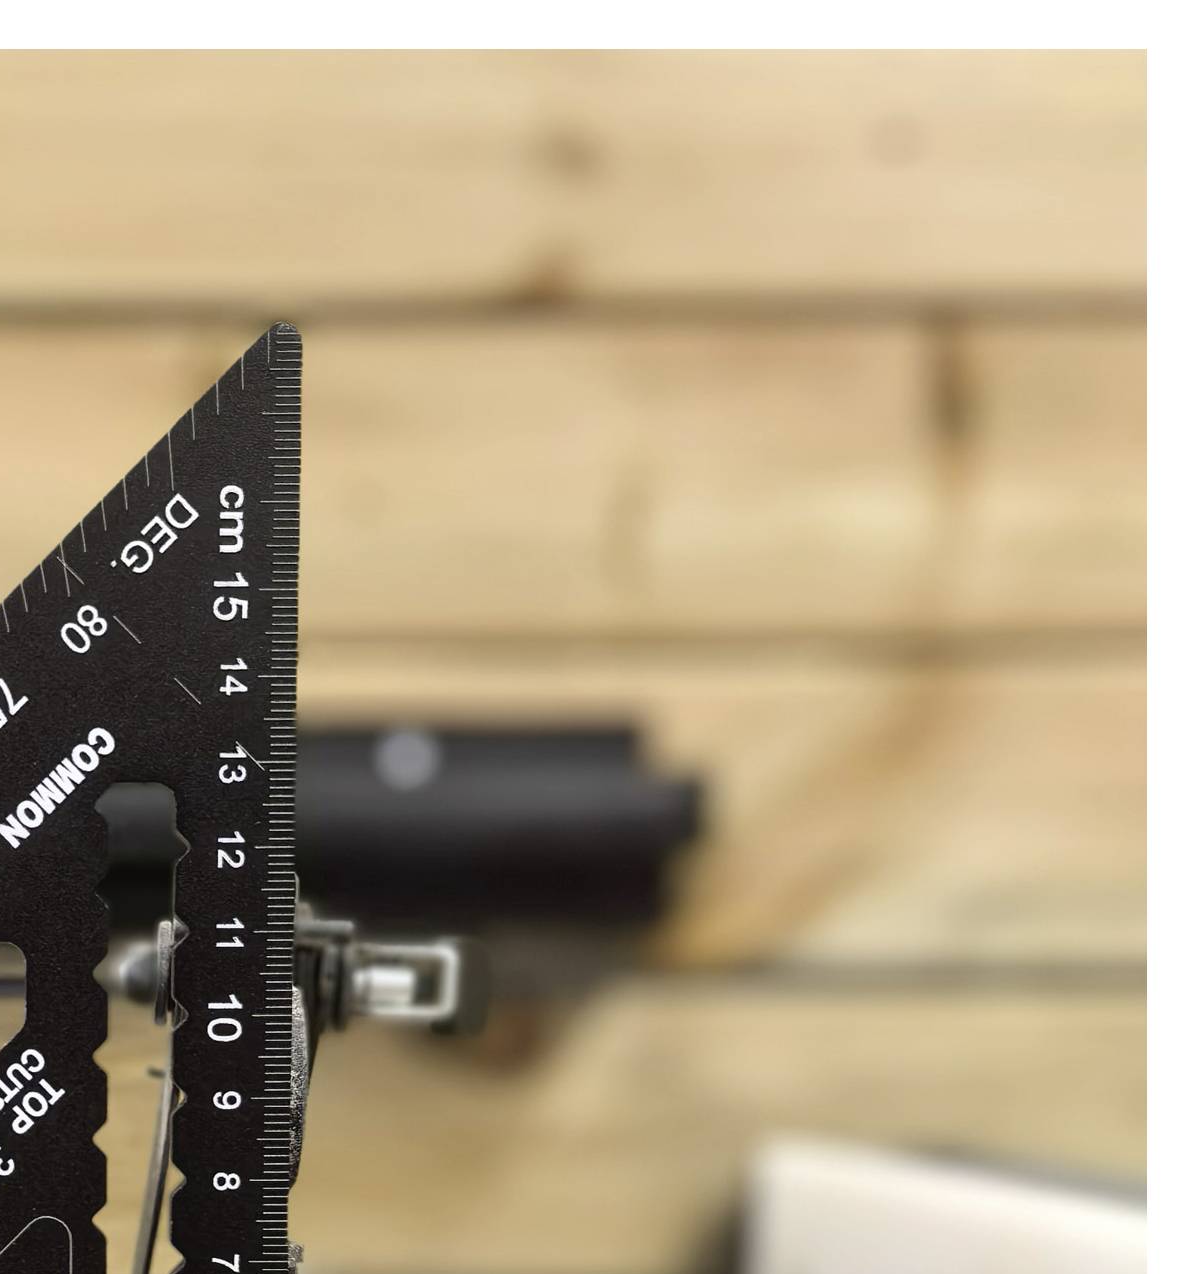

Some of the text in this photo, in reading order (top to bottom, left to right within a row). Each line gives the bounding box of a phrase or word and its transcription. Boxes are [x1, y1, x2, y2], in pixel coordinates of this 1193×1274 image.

[111, 493, 199, 573] DEG.
[219, 485, 244, 552] cm
[213, 572, 249, 620] 15
[61, 605, 107, 653] 80
[220, 658, 248, 696] 14
[218, 744, 247, 785] 13
[218, 831, 245, 868] 12
[216, 918, 244, 947] 11
[207, 994, 242, 1042] 10
[12, 1085, 65, 1134] TOP
[213, 1091, 241, 1109] 9
[213, 1173, 240, 1190] 8
[212, 1254, 239, 1272] 7
